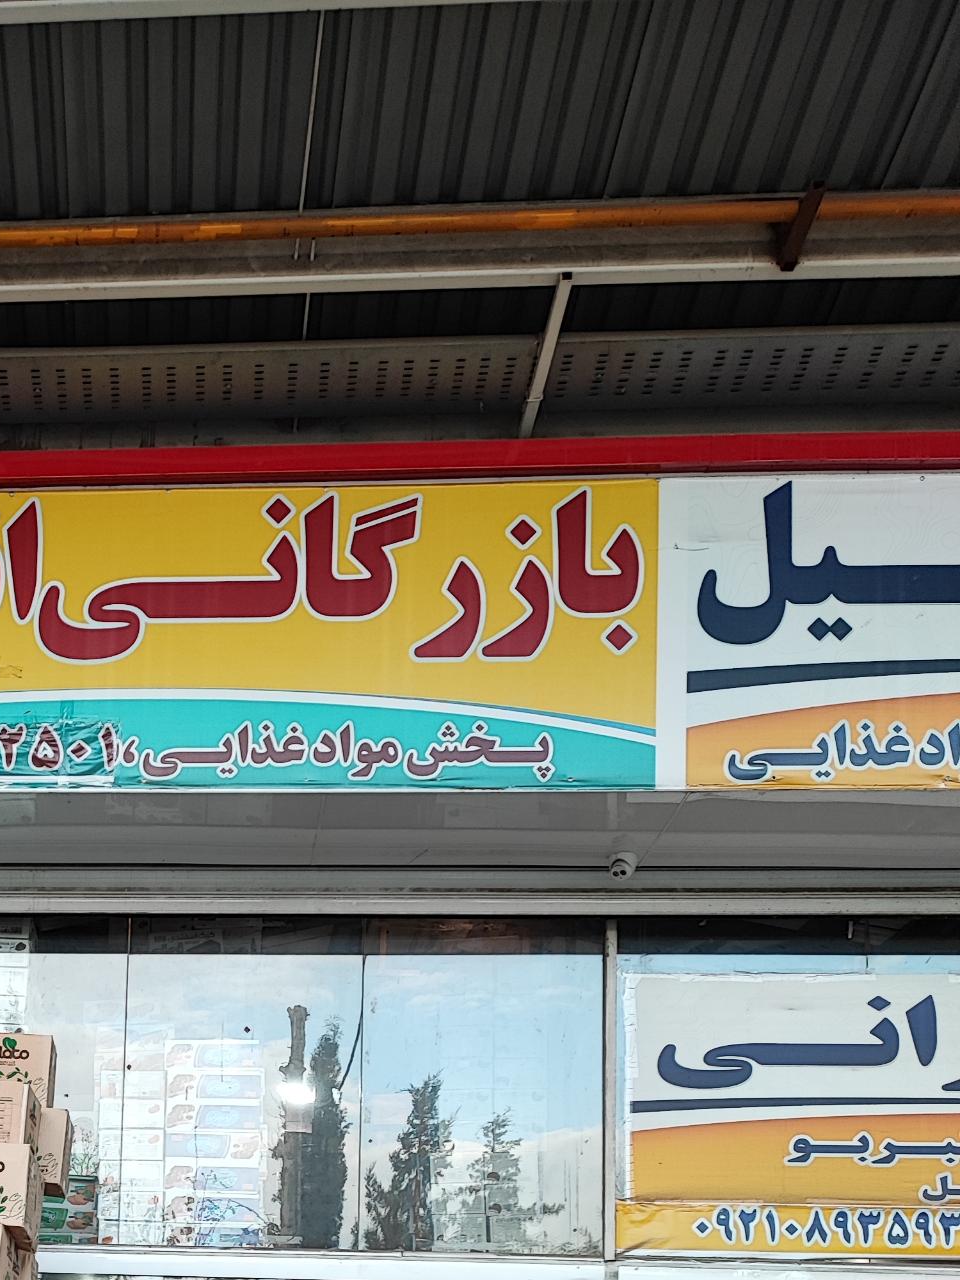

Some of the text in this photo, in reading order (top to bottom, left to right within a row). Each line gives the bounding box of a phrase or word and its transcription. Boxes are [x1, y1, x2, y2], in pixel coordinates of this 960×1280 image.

[312, 720, 400, 780] مواد
[403, 718, 556, 781] پخش
[724, 719, 913, 783] غذایی
